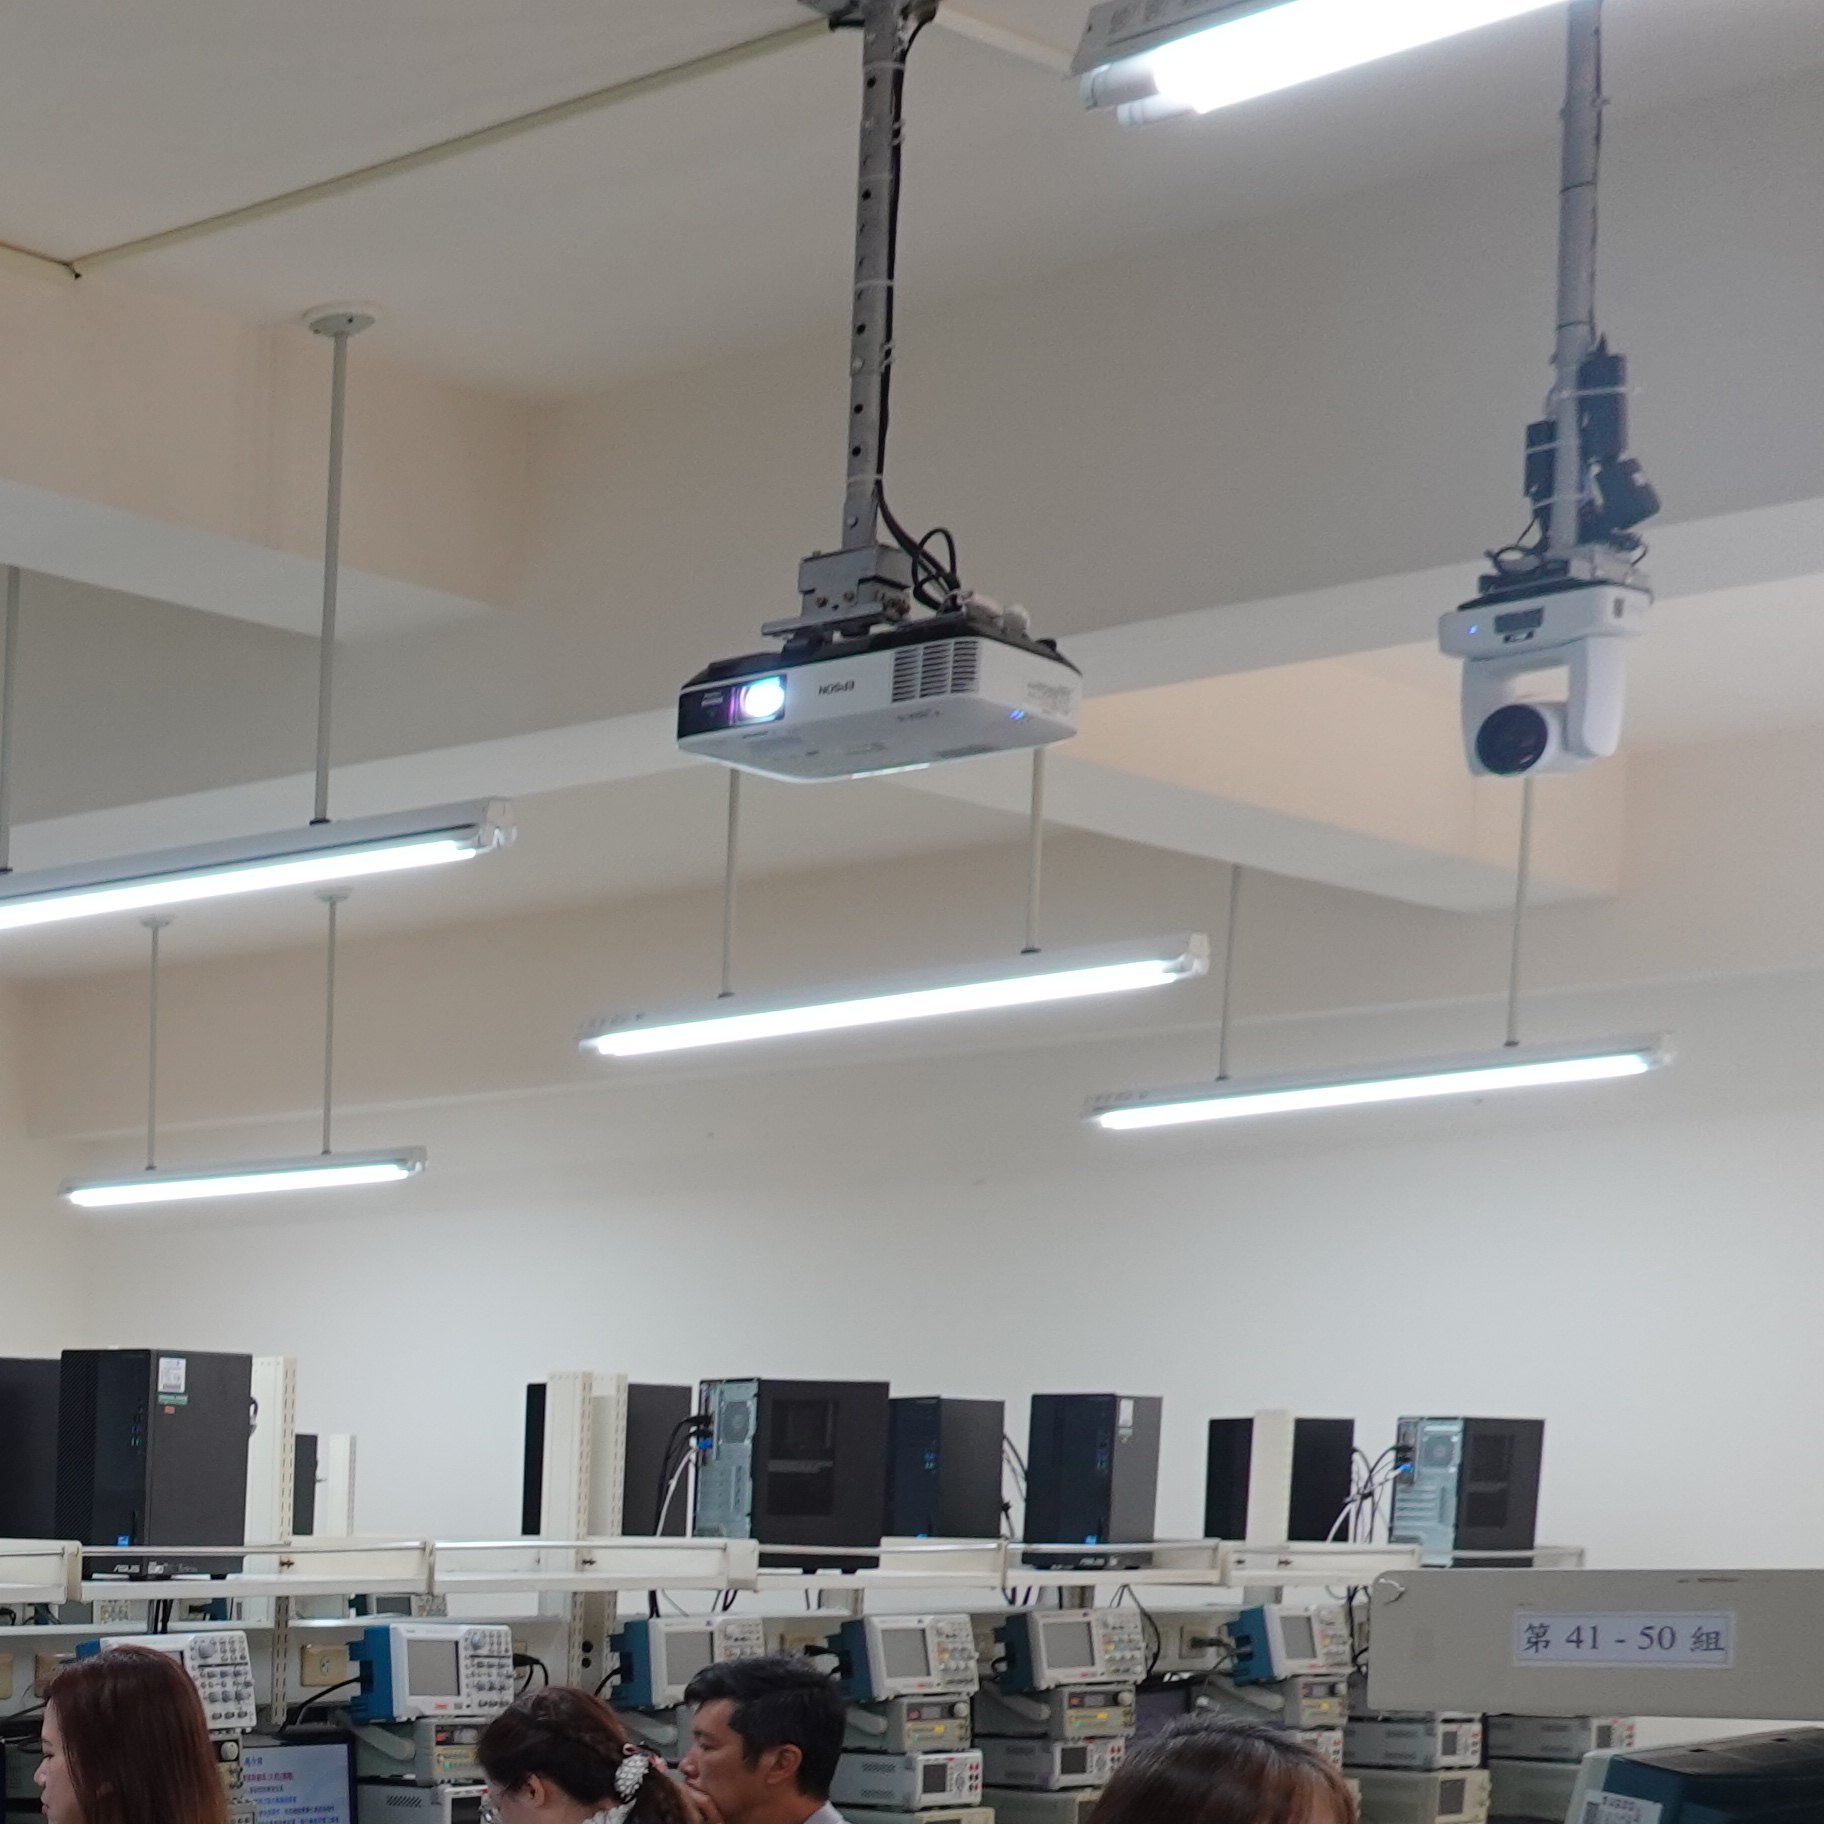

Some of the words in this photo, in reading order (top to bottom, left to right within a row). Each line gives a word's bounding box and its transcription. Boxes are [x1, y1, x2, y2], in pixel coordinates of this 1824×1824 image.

[818, 680, 855, 696] EPSON
[1523, 1622, 1550, 1654] 第
[1565, 1625, 1599, 1650] 41
[1638, 1625, 1677, 1650] 50
[1690, 1626, 1725, 1652] 組
